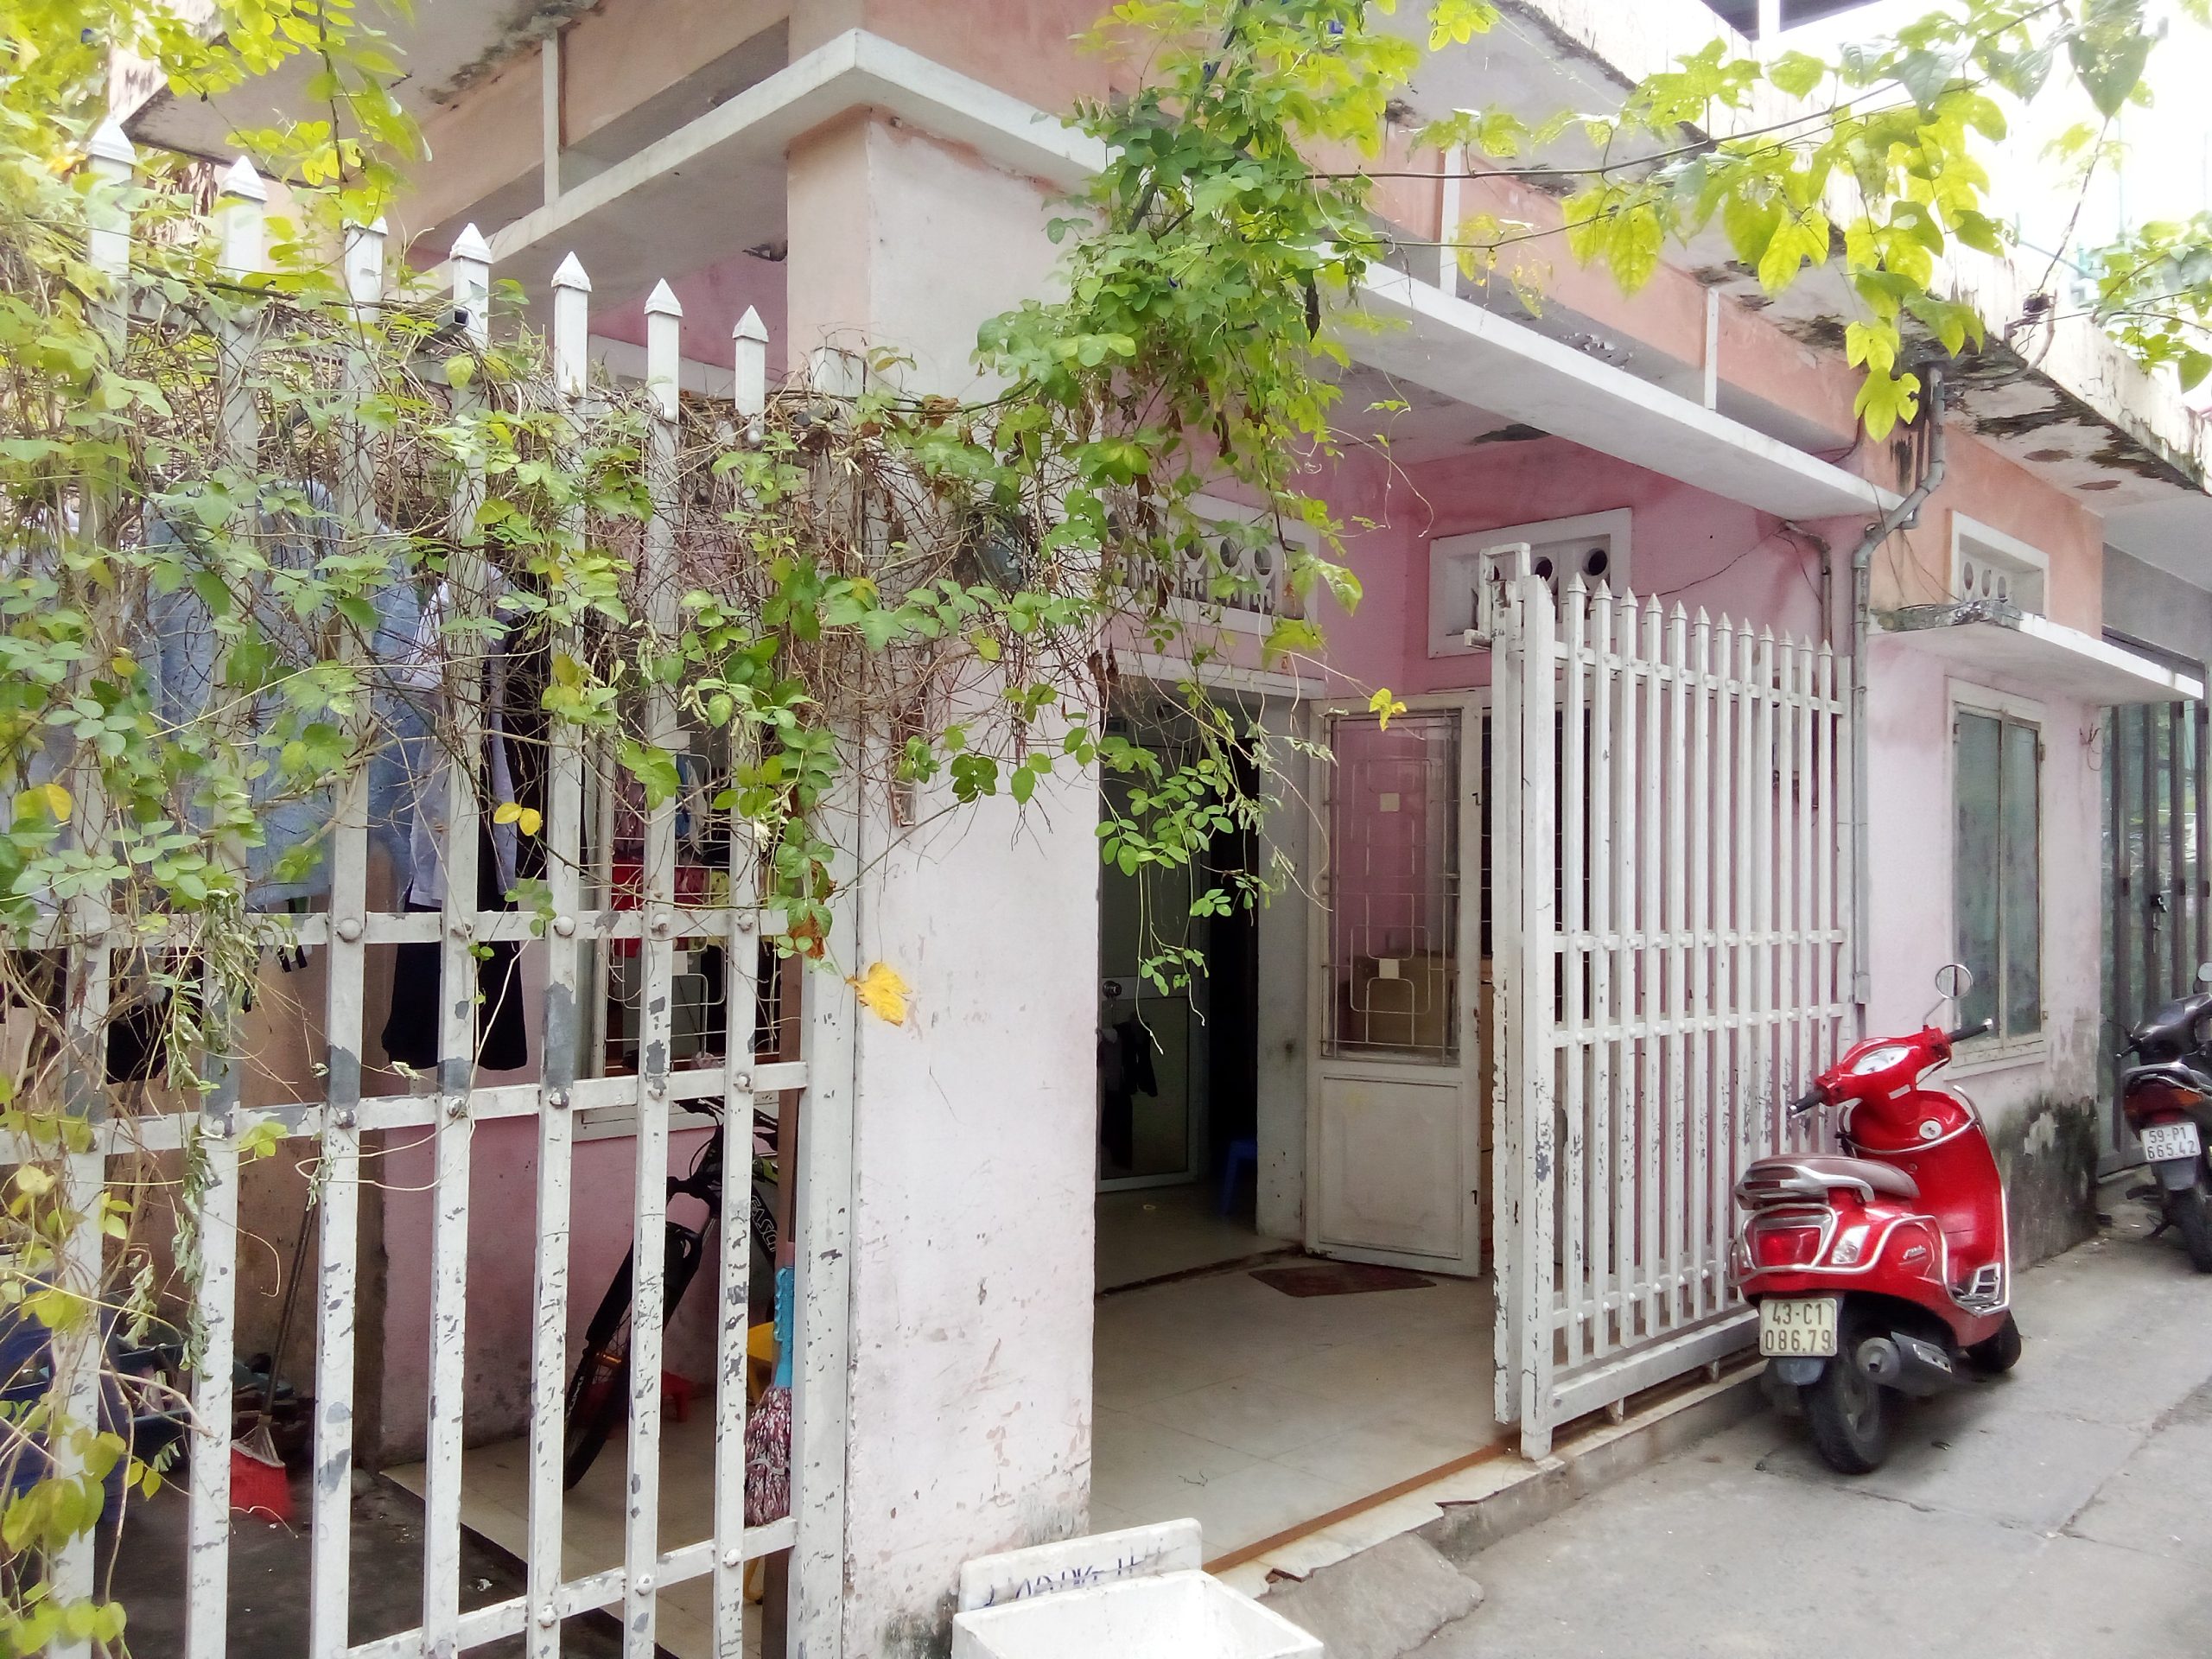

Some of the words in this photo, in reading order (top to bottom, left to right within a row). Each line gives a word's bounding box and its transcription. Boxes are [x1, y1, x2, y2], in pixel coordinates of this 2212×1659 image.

[2149, 1126, 2187, 1143] 59-P1
[2147, 1140, 2196, 1159] 665.42
[1772, 1302, 1822, 1325] 43-C1
[1765, 1329, 1831, 1351] 086.79
